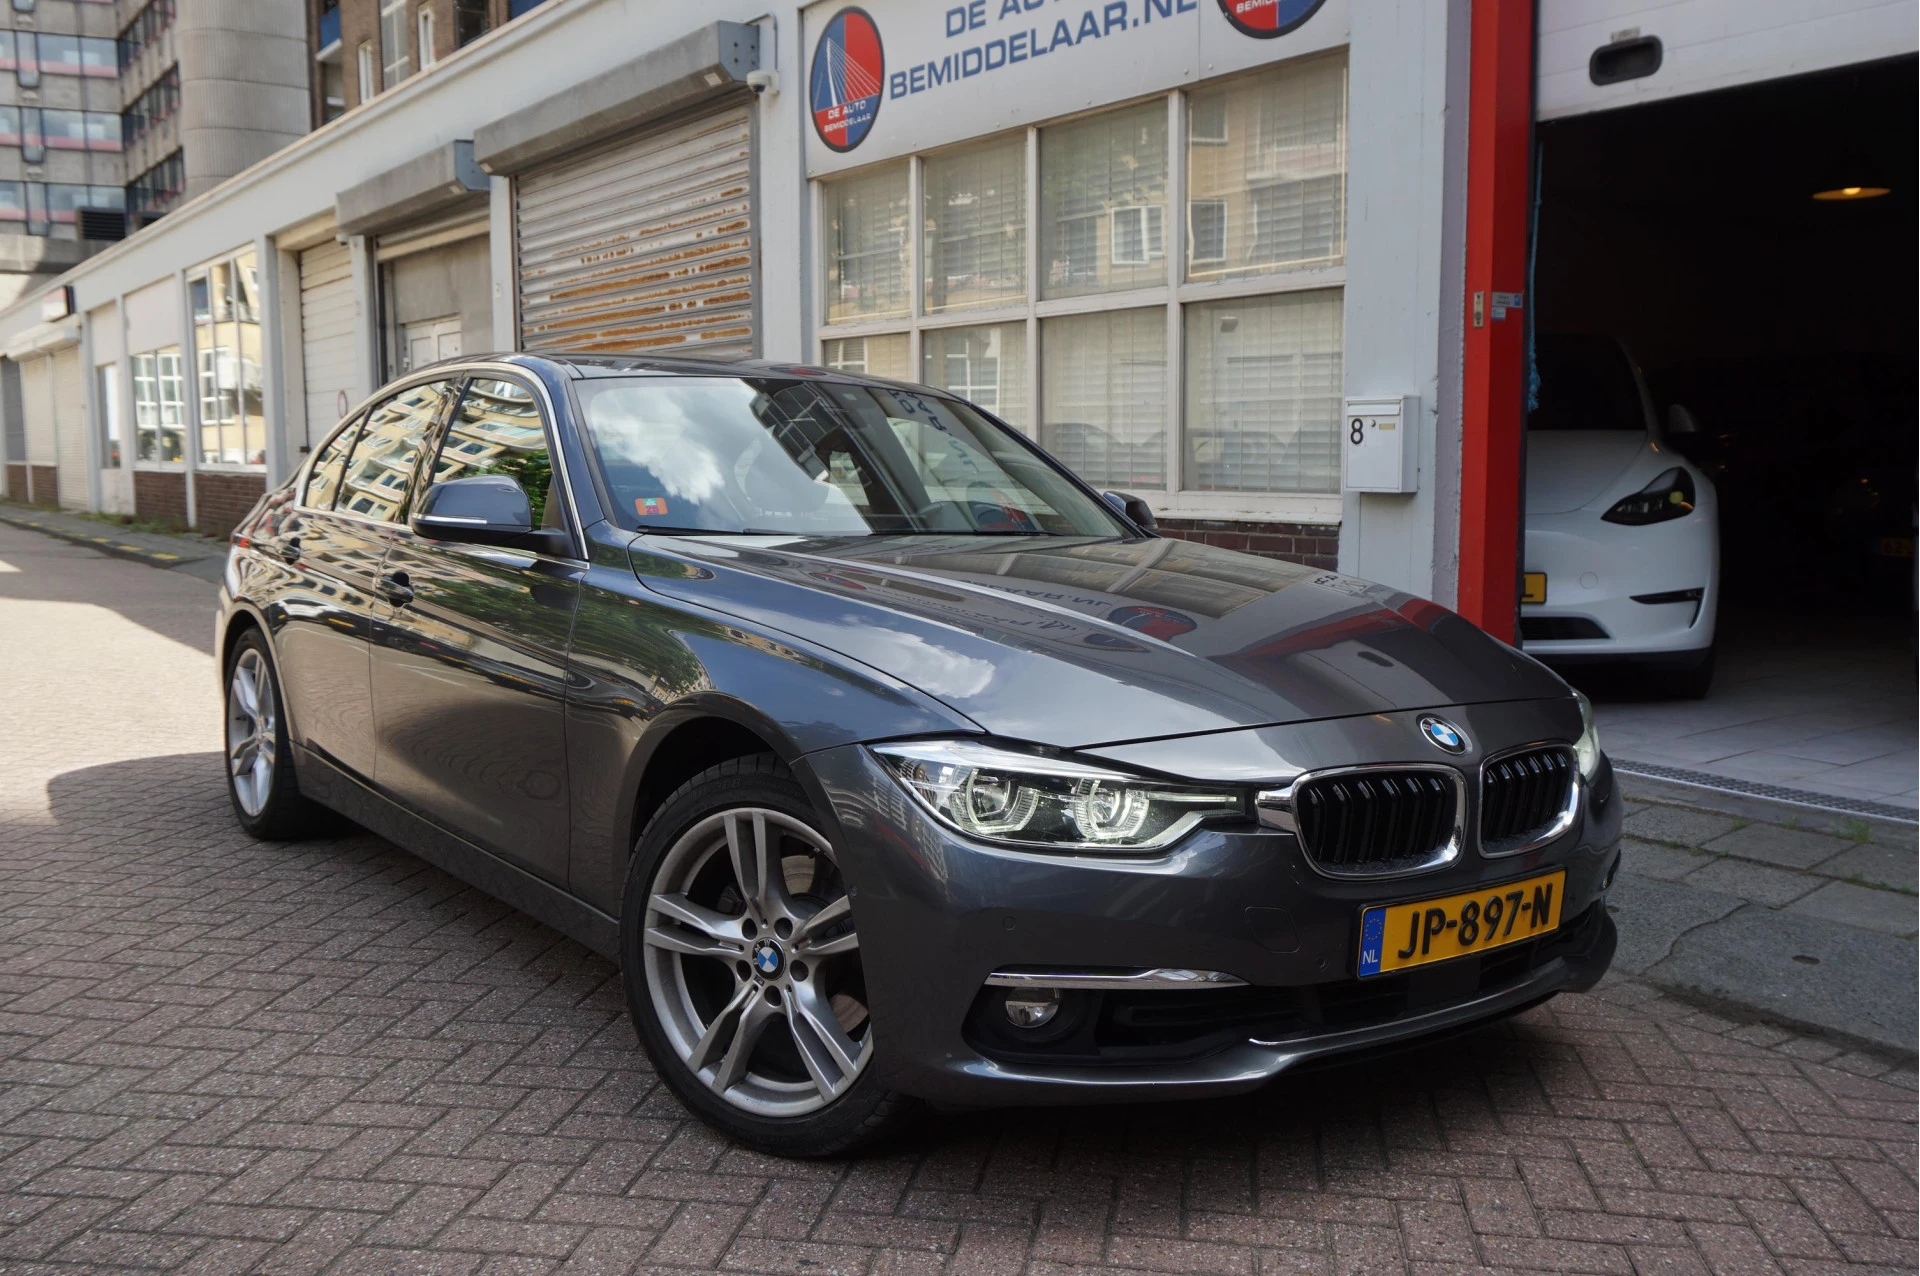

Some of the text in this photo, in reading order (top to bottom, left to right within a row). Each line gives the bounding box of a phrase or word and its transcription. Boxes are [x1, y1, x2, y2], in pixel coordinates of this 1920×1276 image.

[946, 0, 987, 38] DE
[828, 101, 866, 119] DE AUTO
[1350, 417, 1364, 445] 8
[1398, 882, 1553, 959] JP-897-N
[1362, 950, 1379, 965] NL
